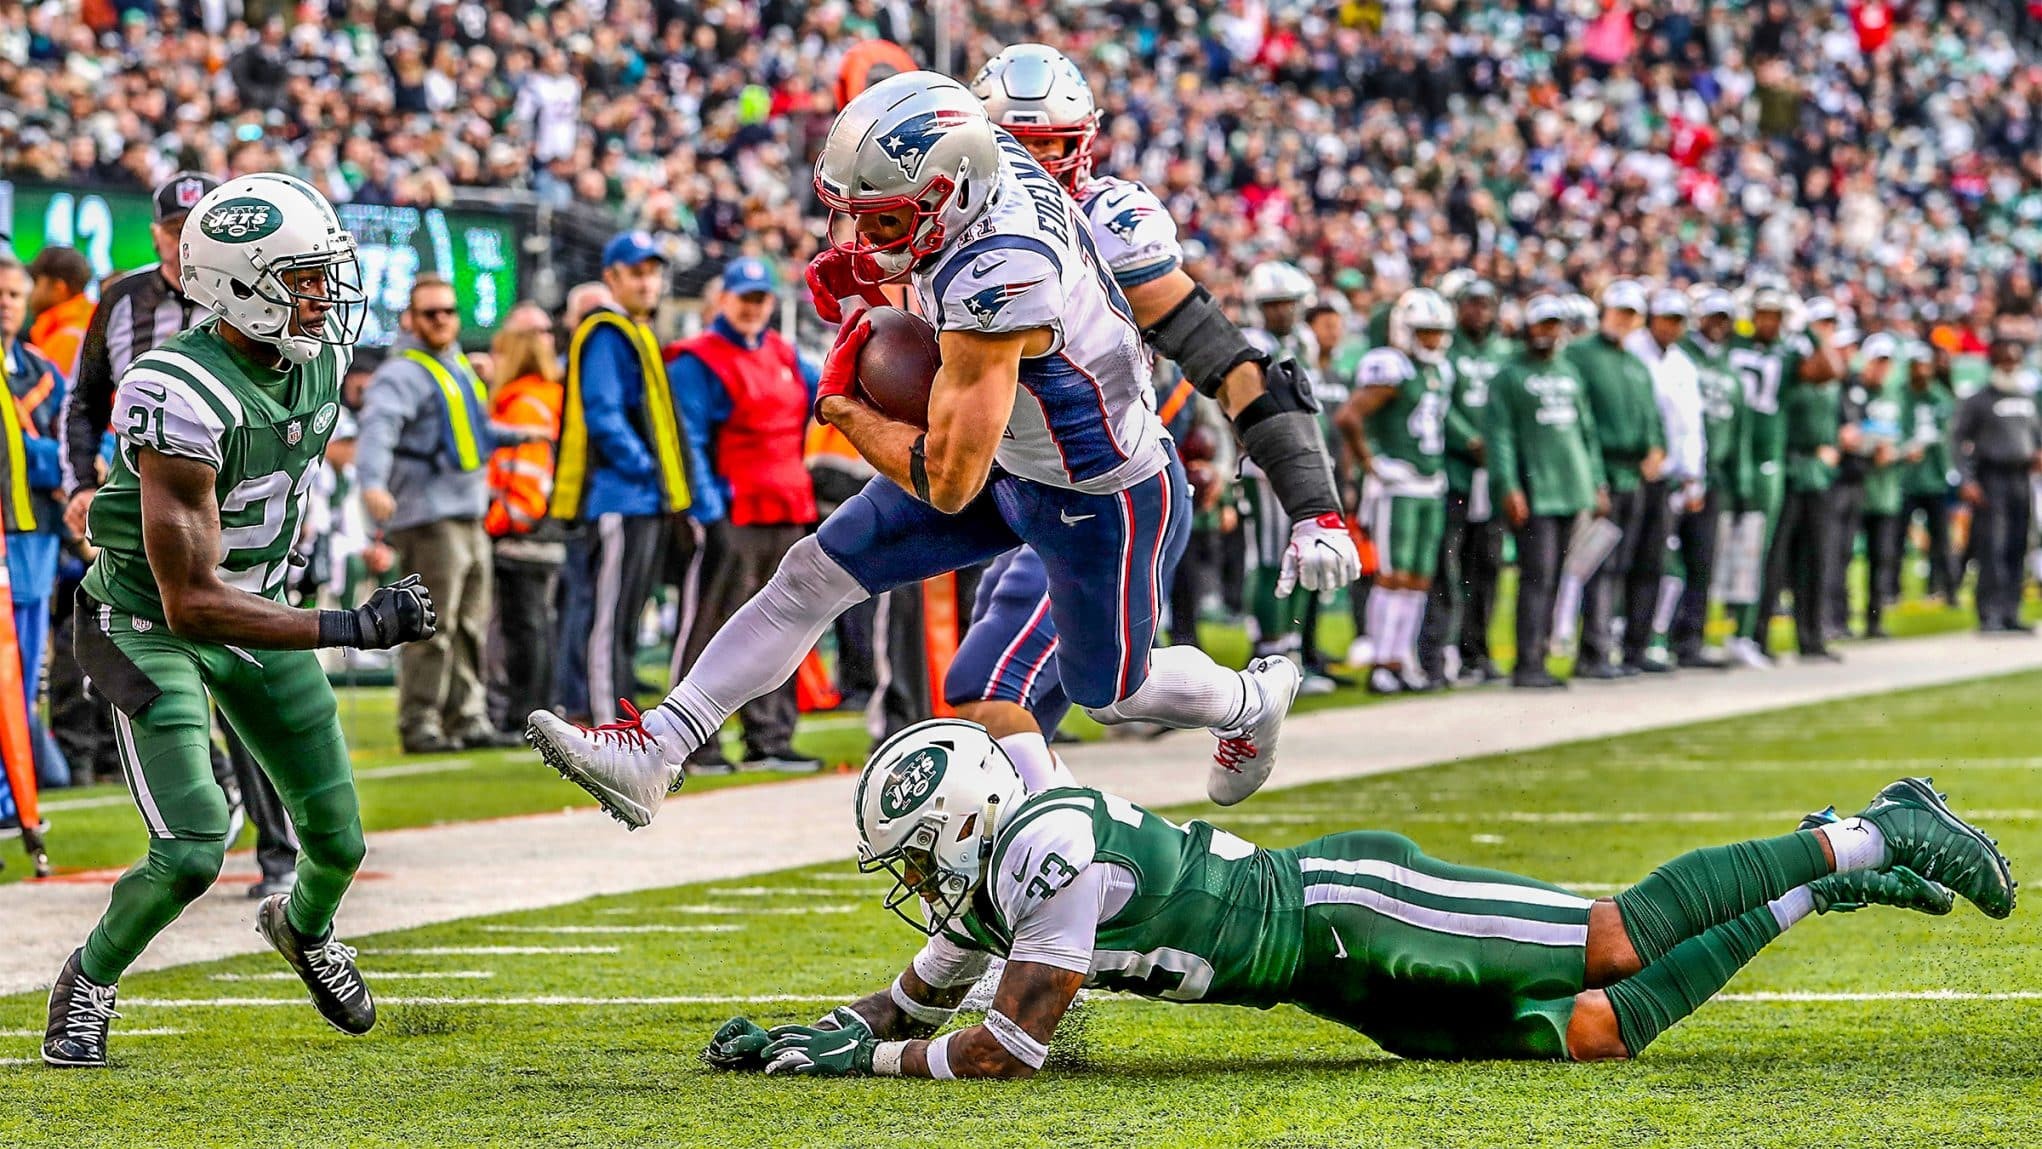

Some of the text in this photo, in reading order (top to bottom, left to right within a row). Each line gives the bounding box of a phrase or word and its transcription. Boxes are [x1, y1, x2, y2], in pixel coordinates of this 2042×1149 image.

[957, 215, 997, 249] 11
[127, 405, 172, 449] 21
[217, 454, 321, 593] 21
[891, 756, 935, 810] JETS
[1026, 851, 1079, 900] 33
